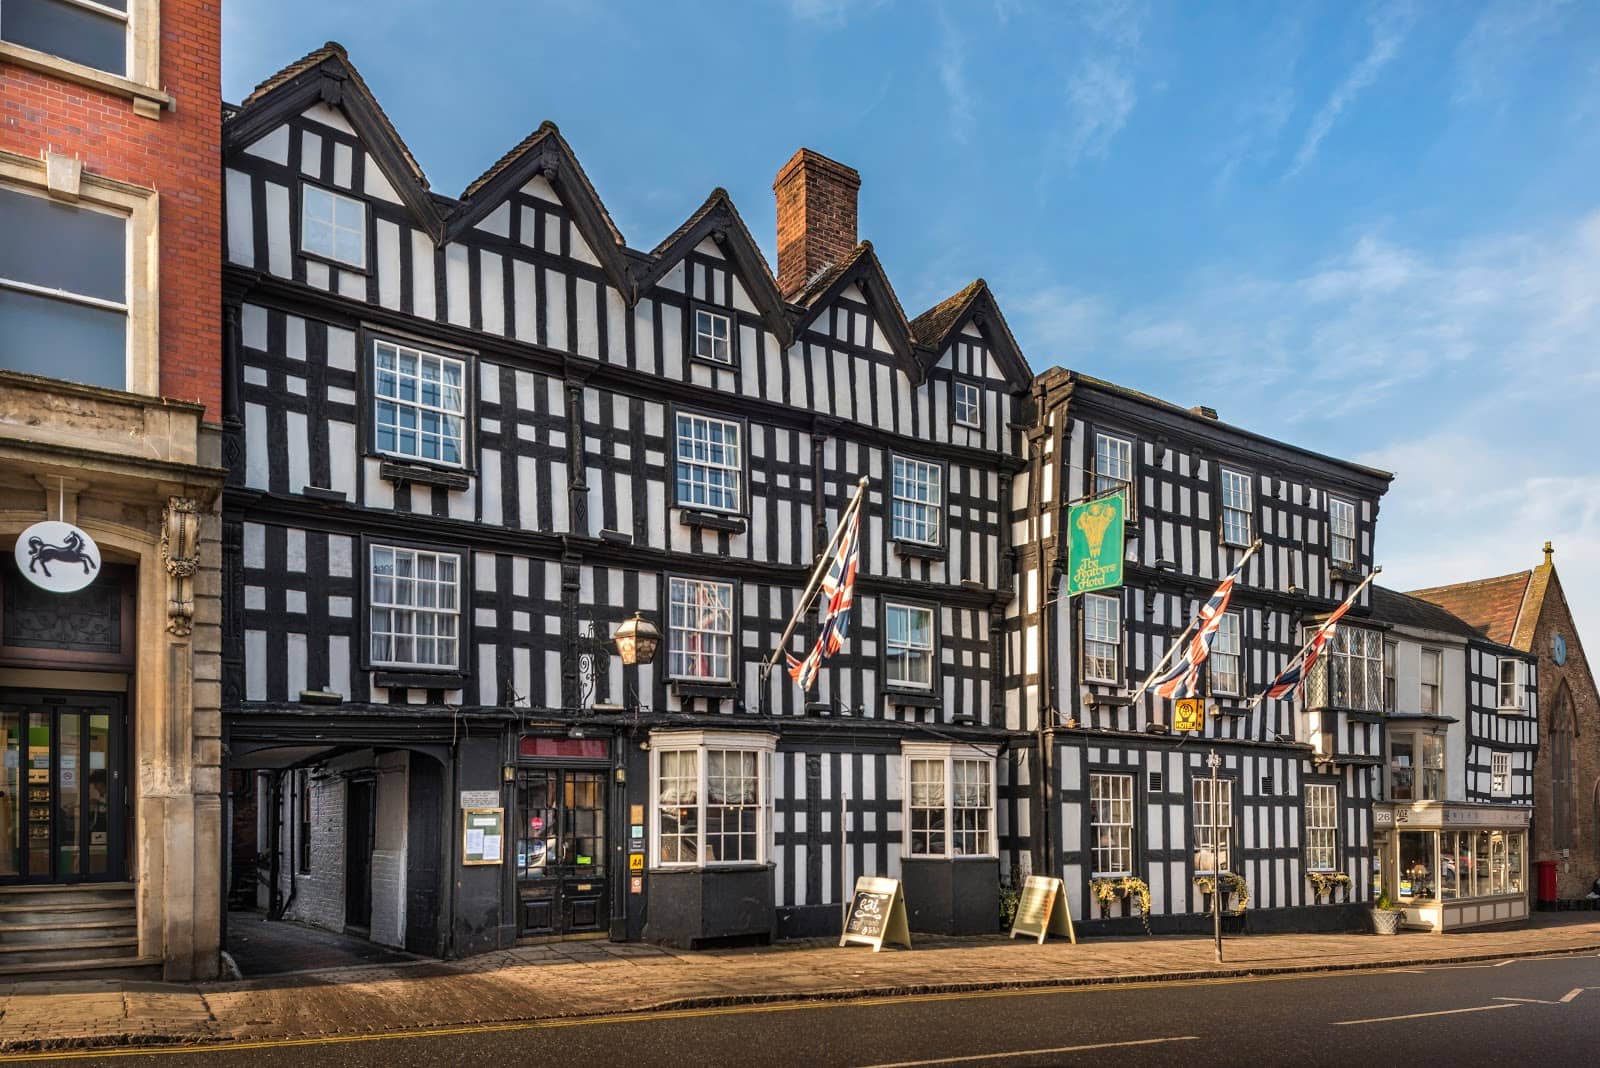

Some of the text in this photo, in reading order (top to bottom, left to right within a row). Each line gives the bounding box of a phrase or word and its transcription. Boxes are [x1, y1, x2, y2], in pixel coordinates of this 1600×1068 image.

[1080, 558, 1098, 570] The
[1175, 721, 1196, 729] HOTEL
[1378, 813, 1390, 821] 26
[631, 858, 642, 867] AA
